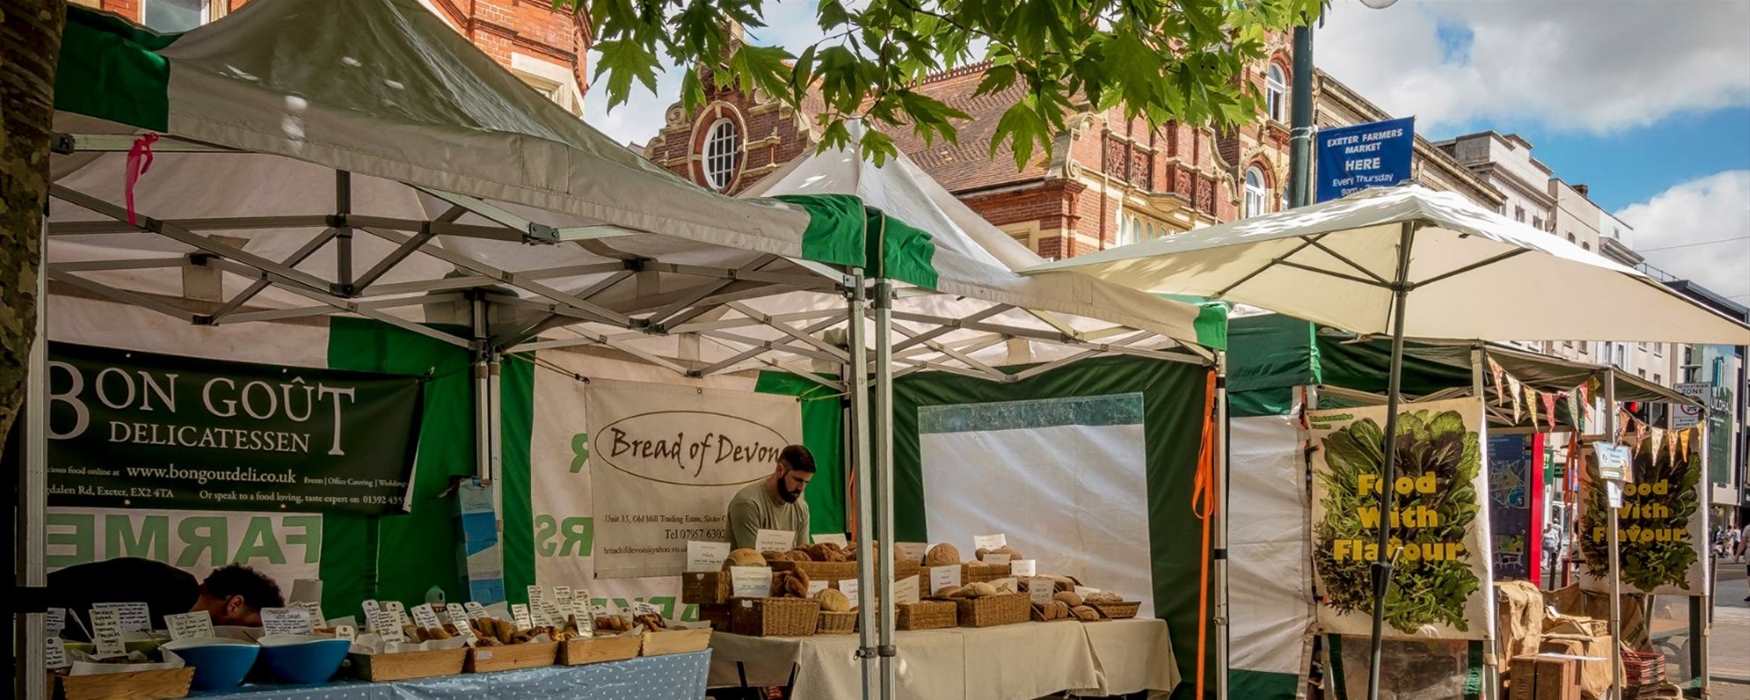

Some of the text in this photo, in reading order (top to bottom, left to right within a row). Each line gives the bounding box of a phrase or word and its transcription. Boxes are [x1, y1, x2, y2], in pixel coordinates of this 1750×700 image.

[1327, 128, 1403, 147] EXETER FARMERS
[1345, 142, 1382, 154] MARKET
[1345, 157, 1381, 171] HERE
[1332, 173, 1394, 187] Every Thursday
[47, 360, 355, 456] BON GOÛT
[109, 421, 310, 453] DELICATESSEN
[611, 427, 685, 470] Bread
[689, 433, 713, 478] of
[715, 434, 779, 464] Devon
[126, 463, 296, 485] www.bongoutdeli.co.uk
[130, 487, 152, 498] EX2
[199, 490, 212, 500] Or
[214, 490, 238, 502] speak
[239, 492, 249, 500] to
[256, 491, 275, 501] food
[1623, 478, 1669, 497] ood
[1356, 505, 1439, 529] With
[664, 528, 679, 540] Tel
[1592, 525, 1689, 544] Favour
